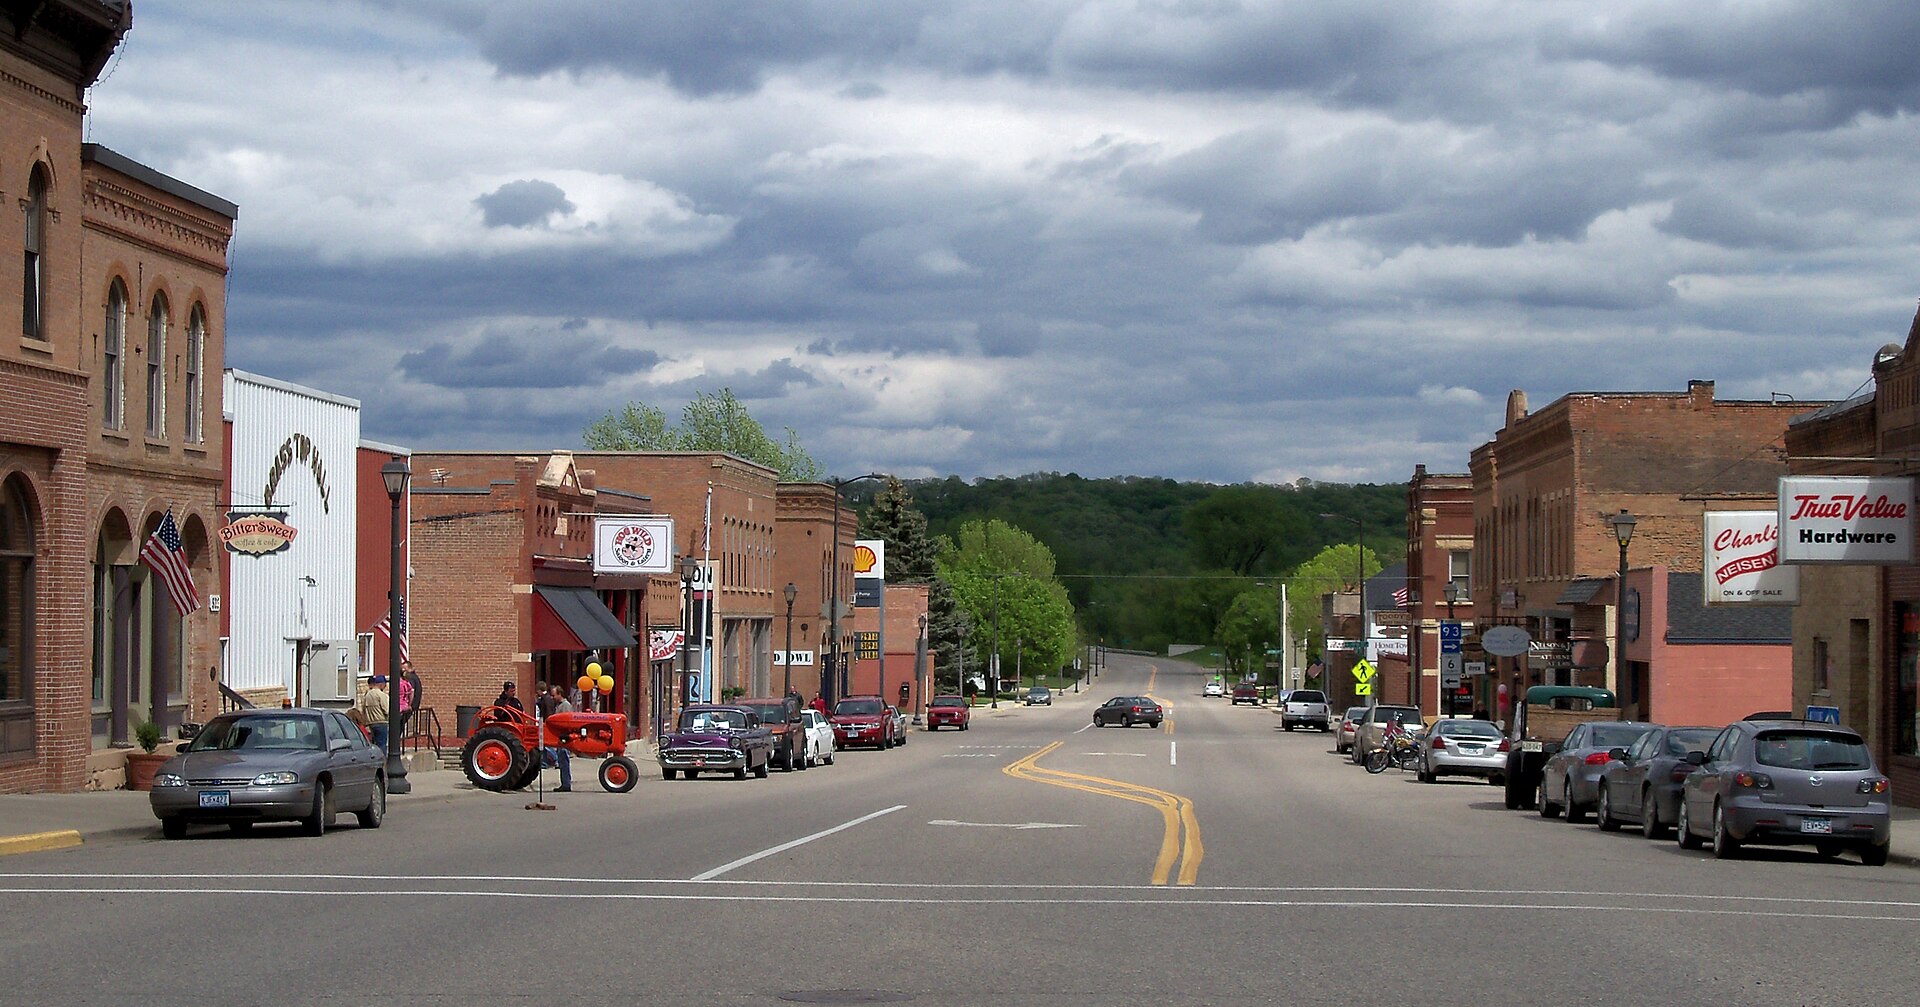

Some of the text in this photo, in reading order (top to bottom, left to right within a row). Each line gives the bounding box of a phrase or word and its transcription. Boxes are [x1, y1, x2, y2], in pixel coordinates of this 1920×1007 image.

[220, 521, 294, 540] BitterSweet
[615, 526, 652, 546] HOG WILD
[1799, 529, 1896, 544] Hardware
[614, 547, 629, 566] Saloon
[637, 548, 652, 566] Eatery
[1442, 626, 1460, 637] 93
[652, 633, 685, 659] Eatery
[1530, 641, 1560, 650] NELSON
[1447, 660, 1455, 669] 6
